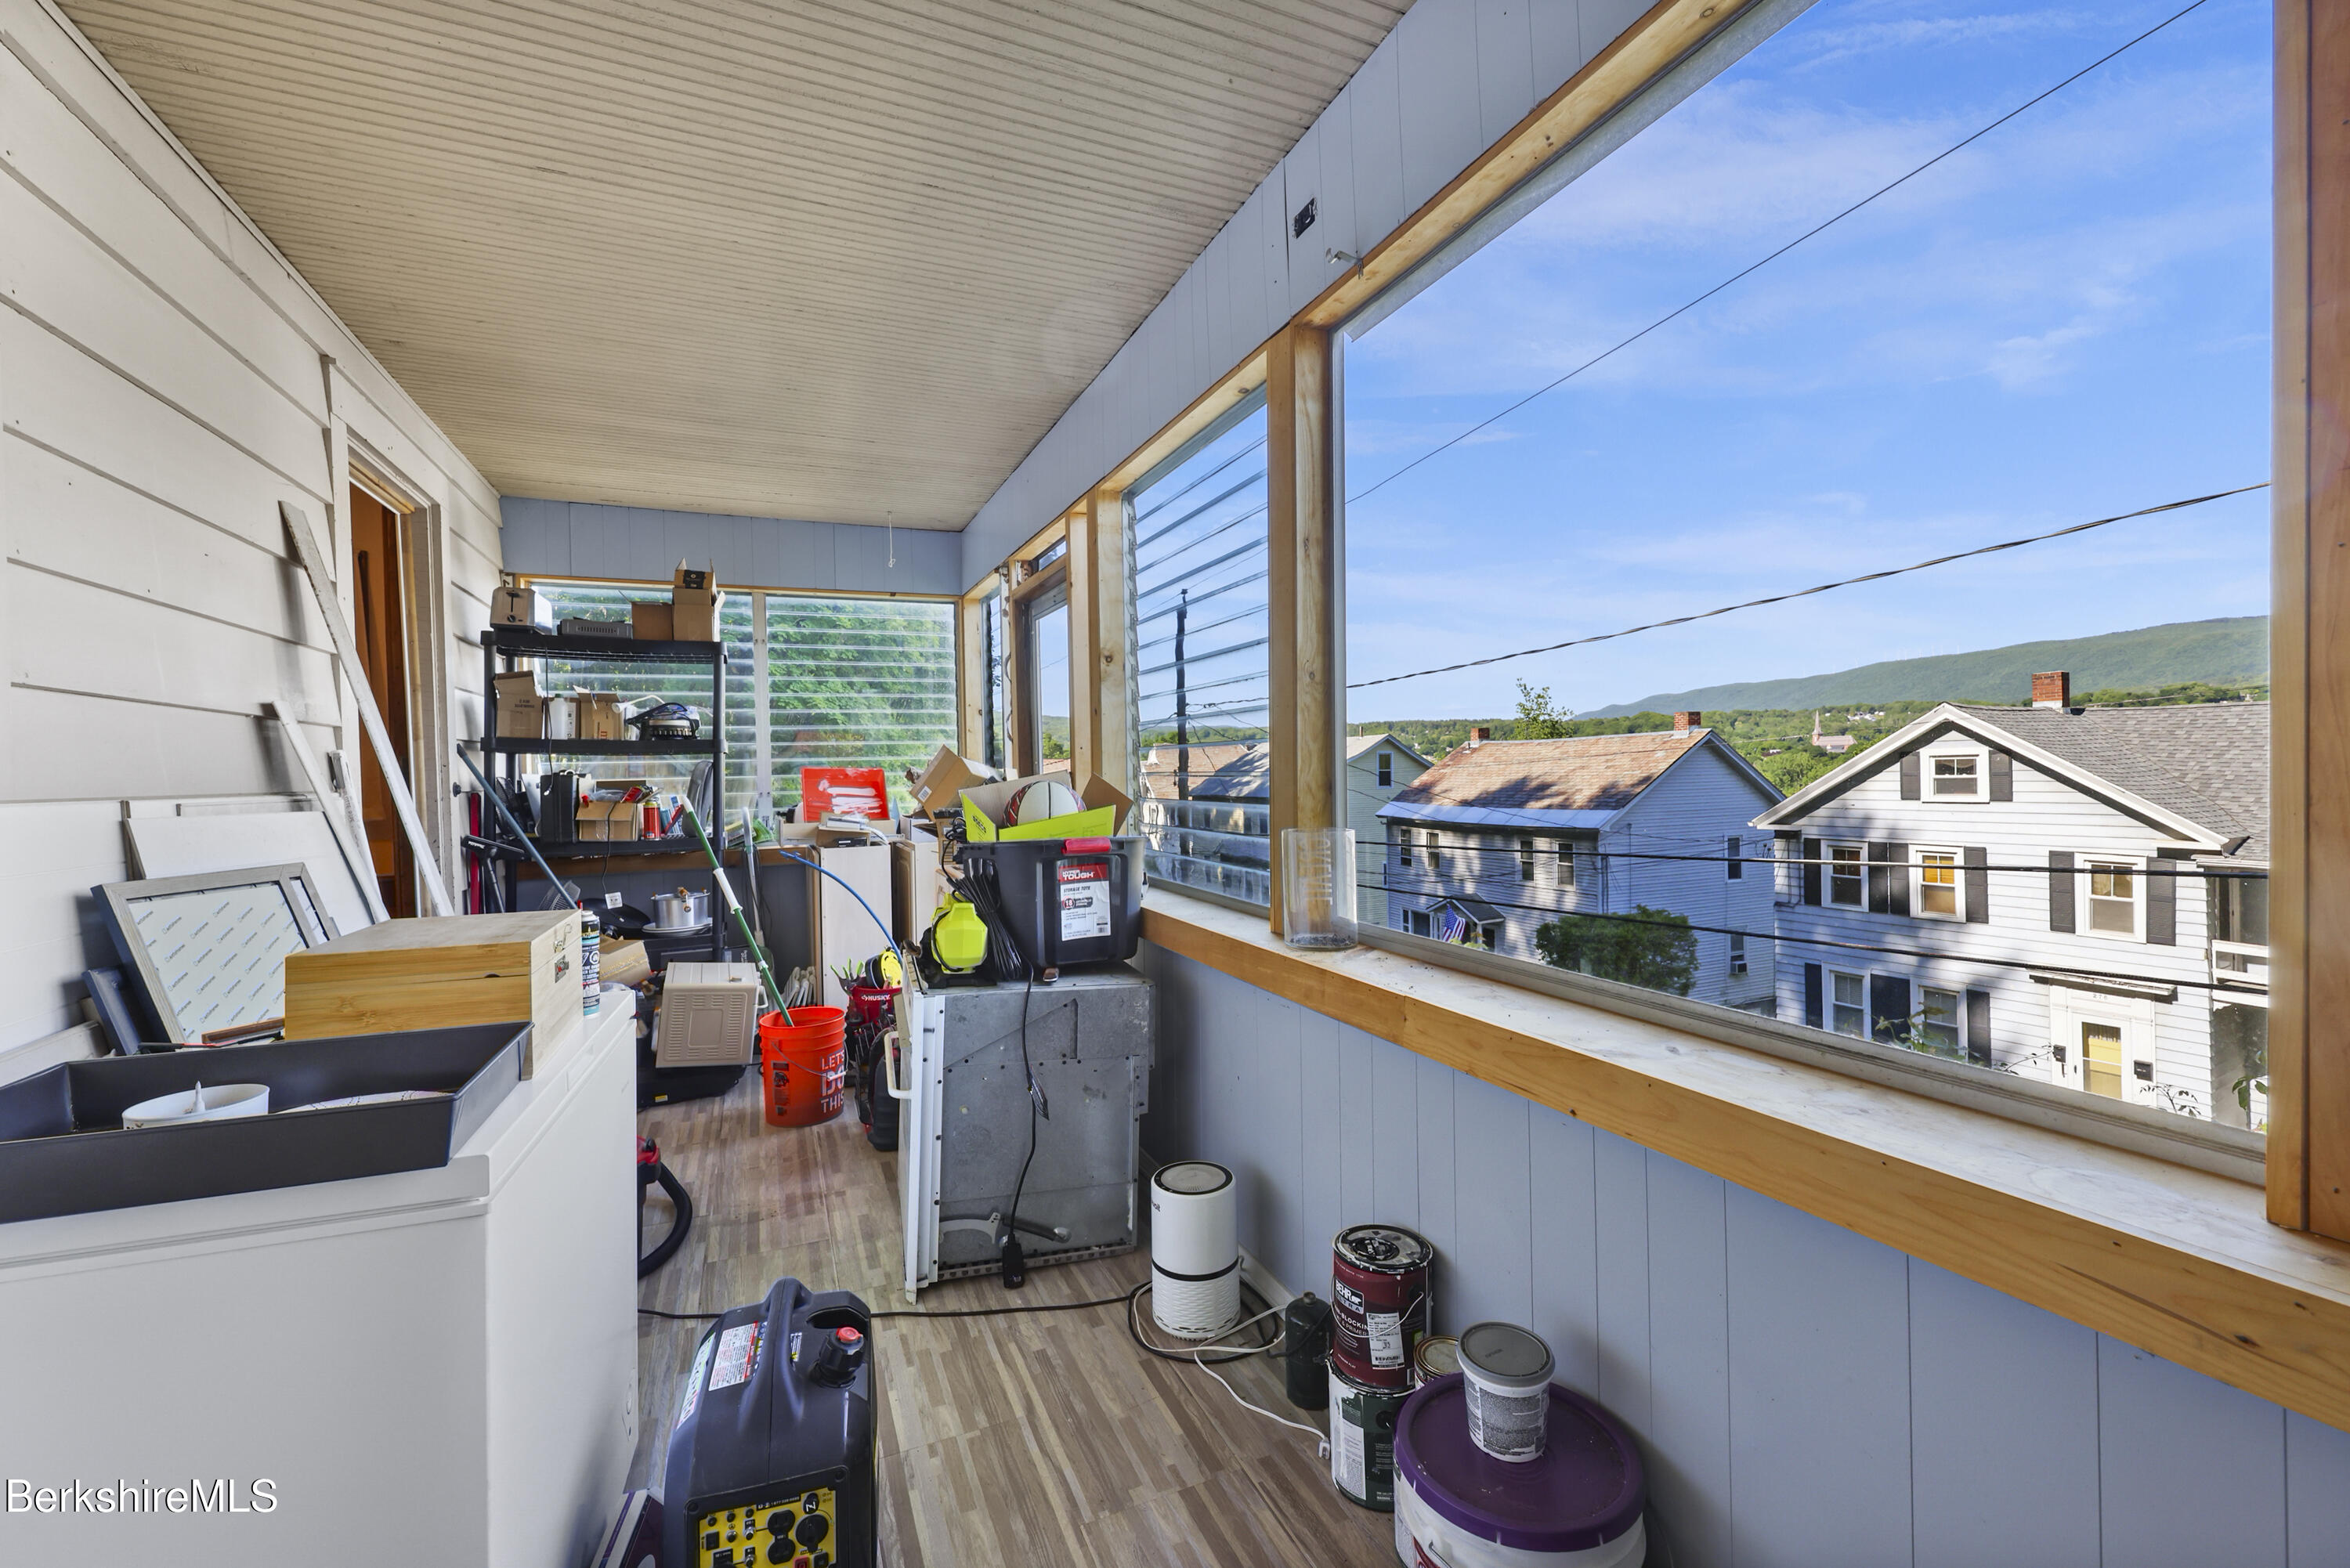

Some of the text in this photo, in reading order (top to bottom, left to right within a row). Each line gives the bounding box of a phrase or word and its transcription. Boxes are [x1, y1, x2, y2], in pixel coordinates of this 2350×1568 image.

[1063, 870, 1094, 880] TOUGH
[821, 1089, 844, 1113] THIS
[1336, 1279, 1352, 1301] BEHR
